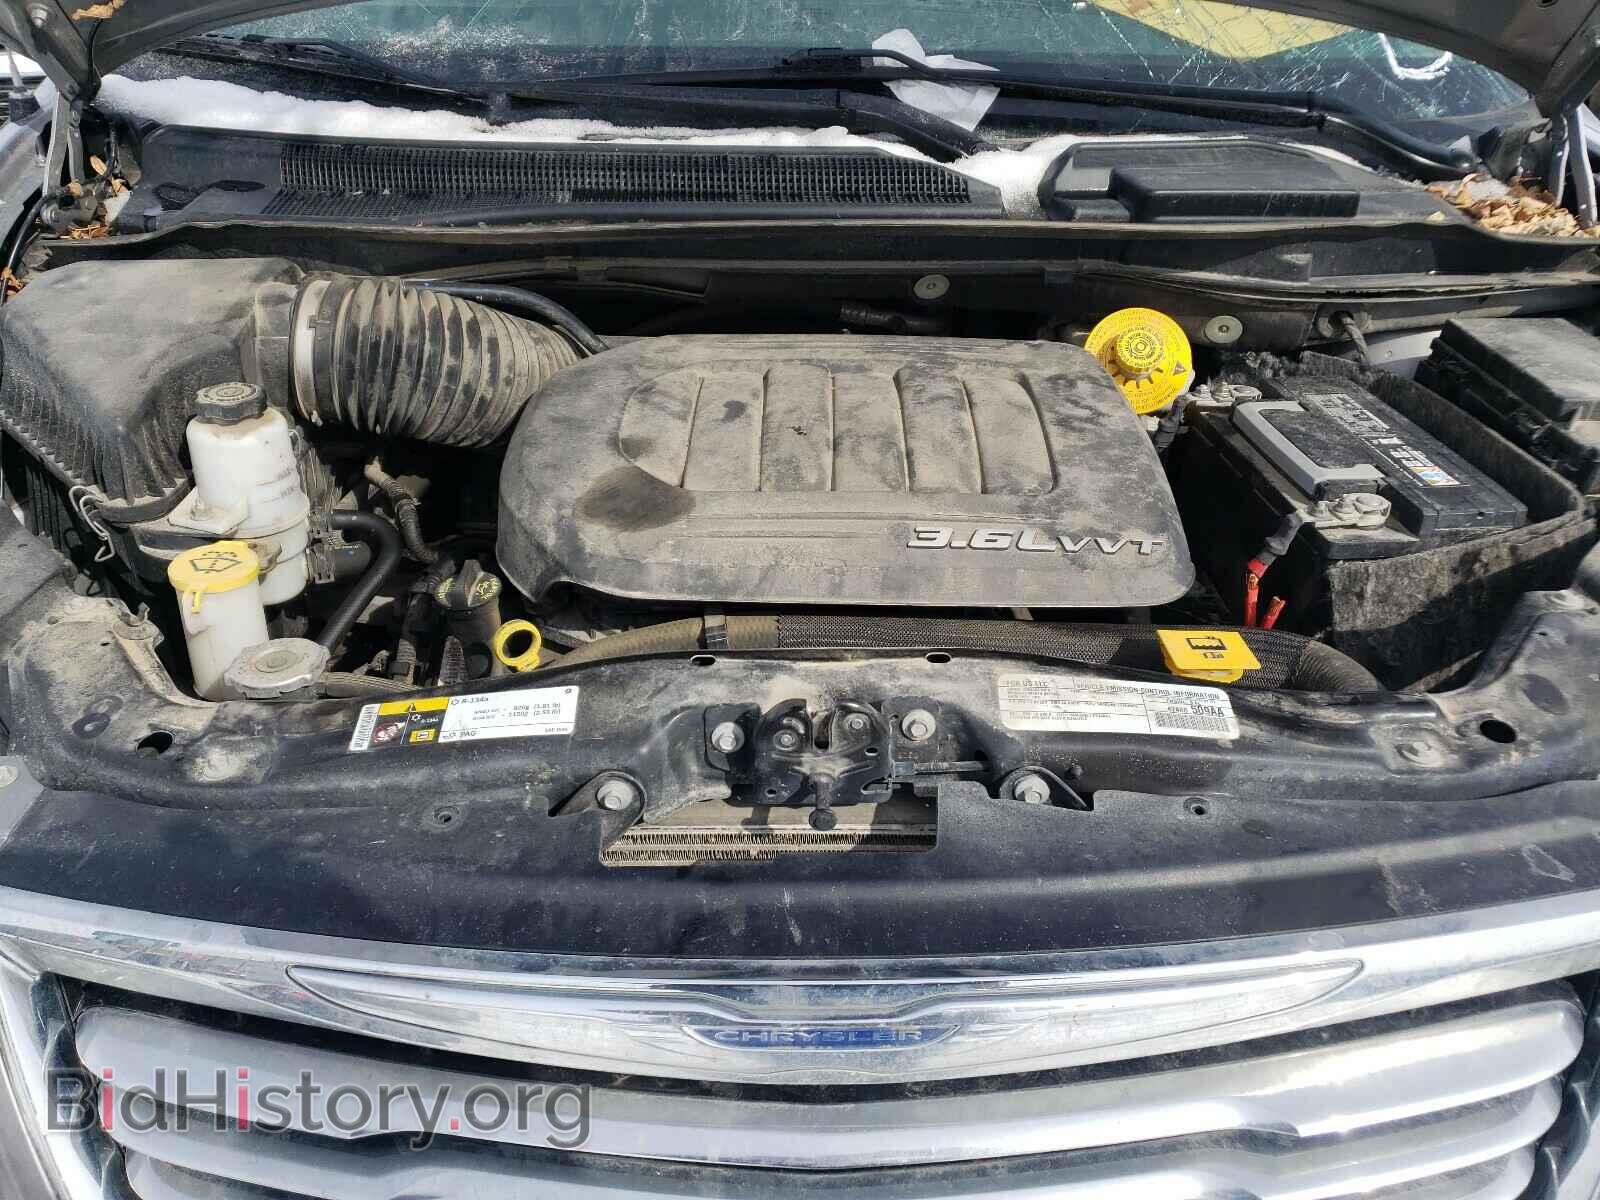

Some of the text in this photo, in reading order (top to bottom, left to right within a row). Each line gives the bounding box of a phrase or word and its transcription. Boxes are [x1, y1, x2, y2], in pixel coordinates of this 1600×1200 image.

[1106, 685, 1139, 694] EMISSION
[1140, 688, 1170, 697] CONTROL
[1173, 690, 1220, 700] INFORMATION
[714, 1030, 922, 1042] CHRYSLER
